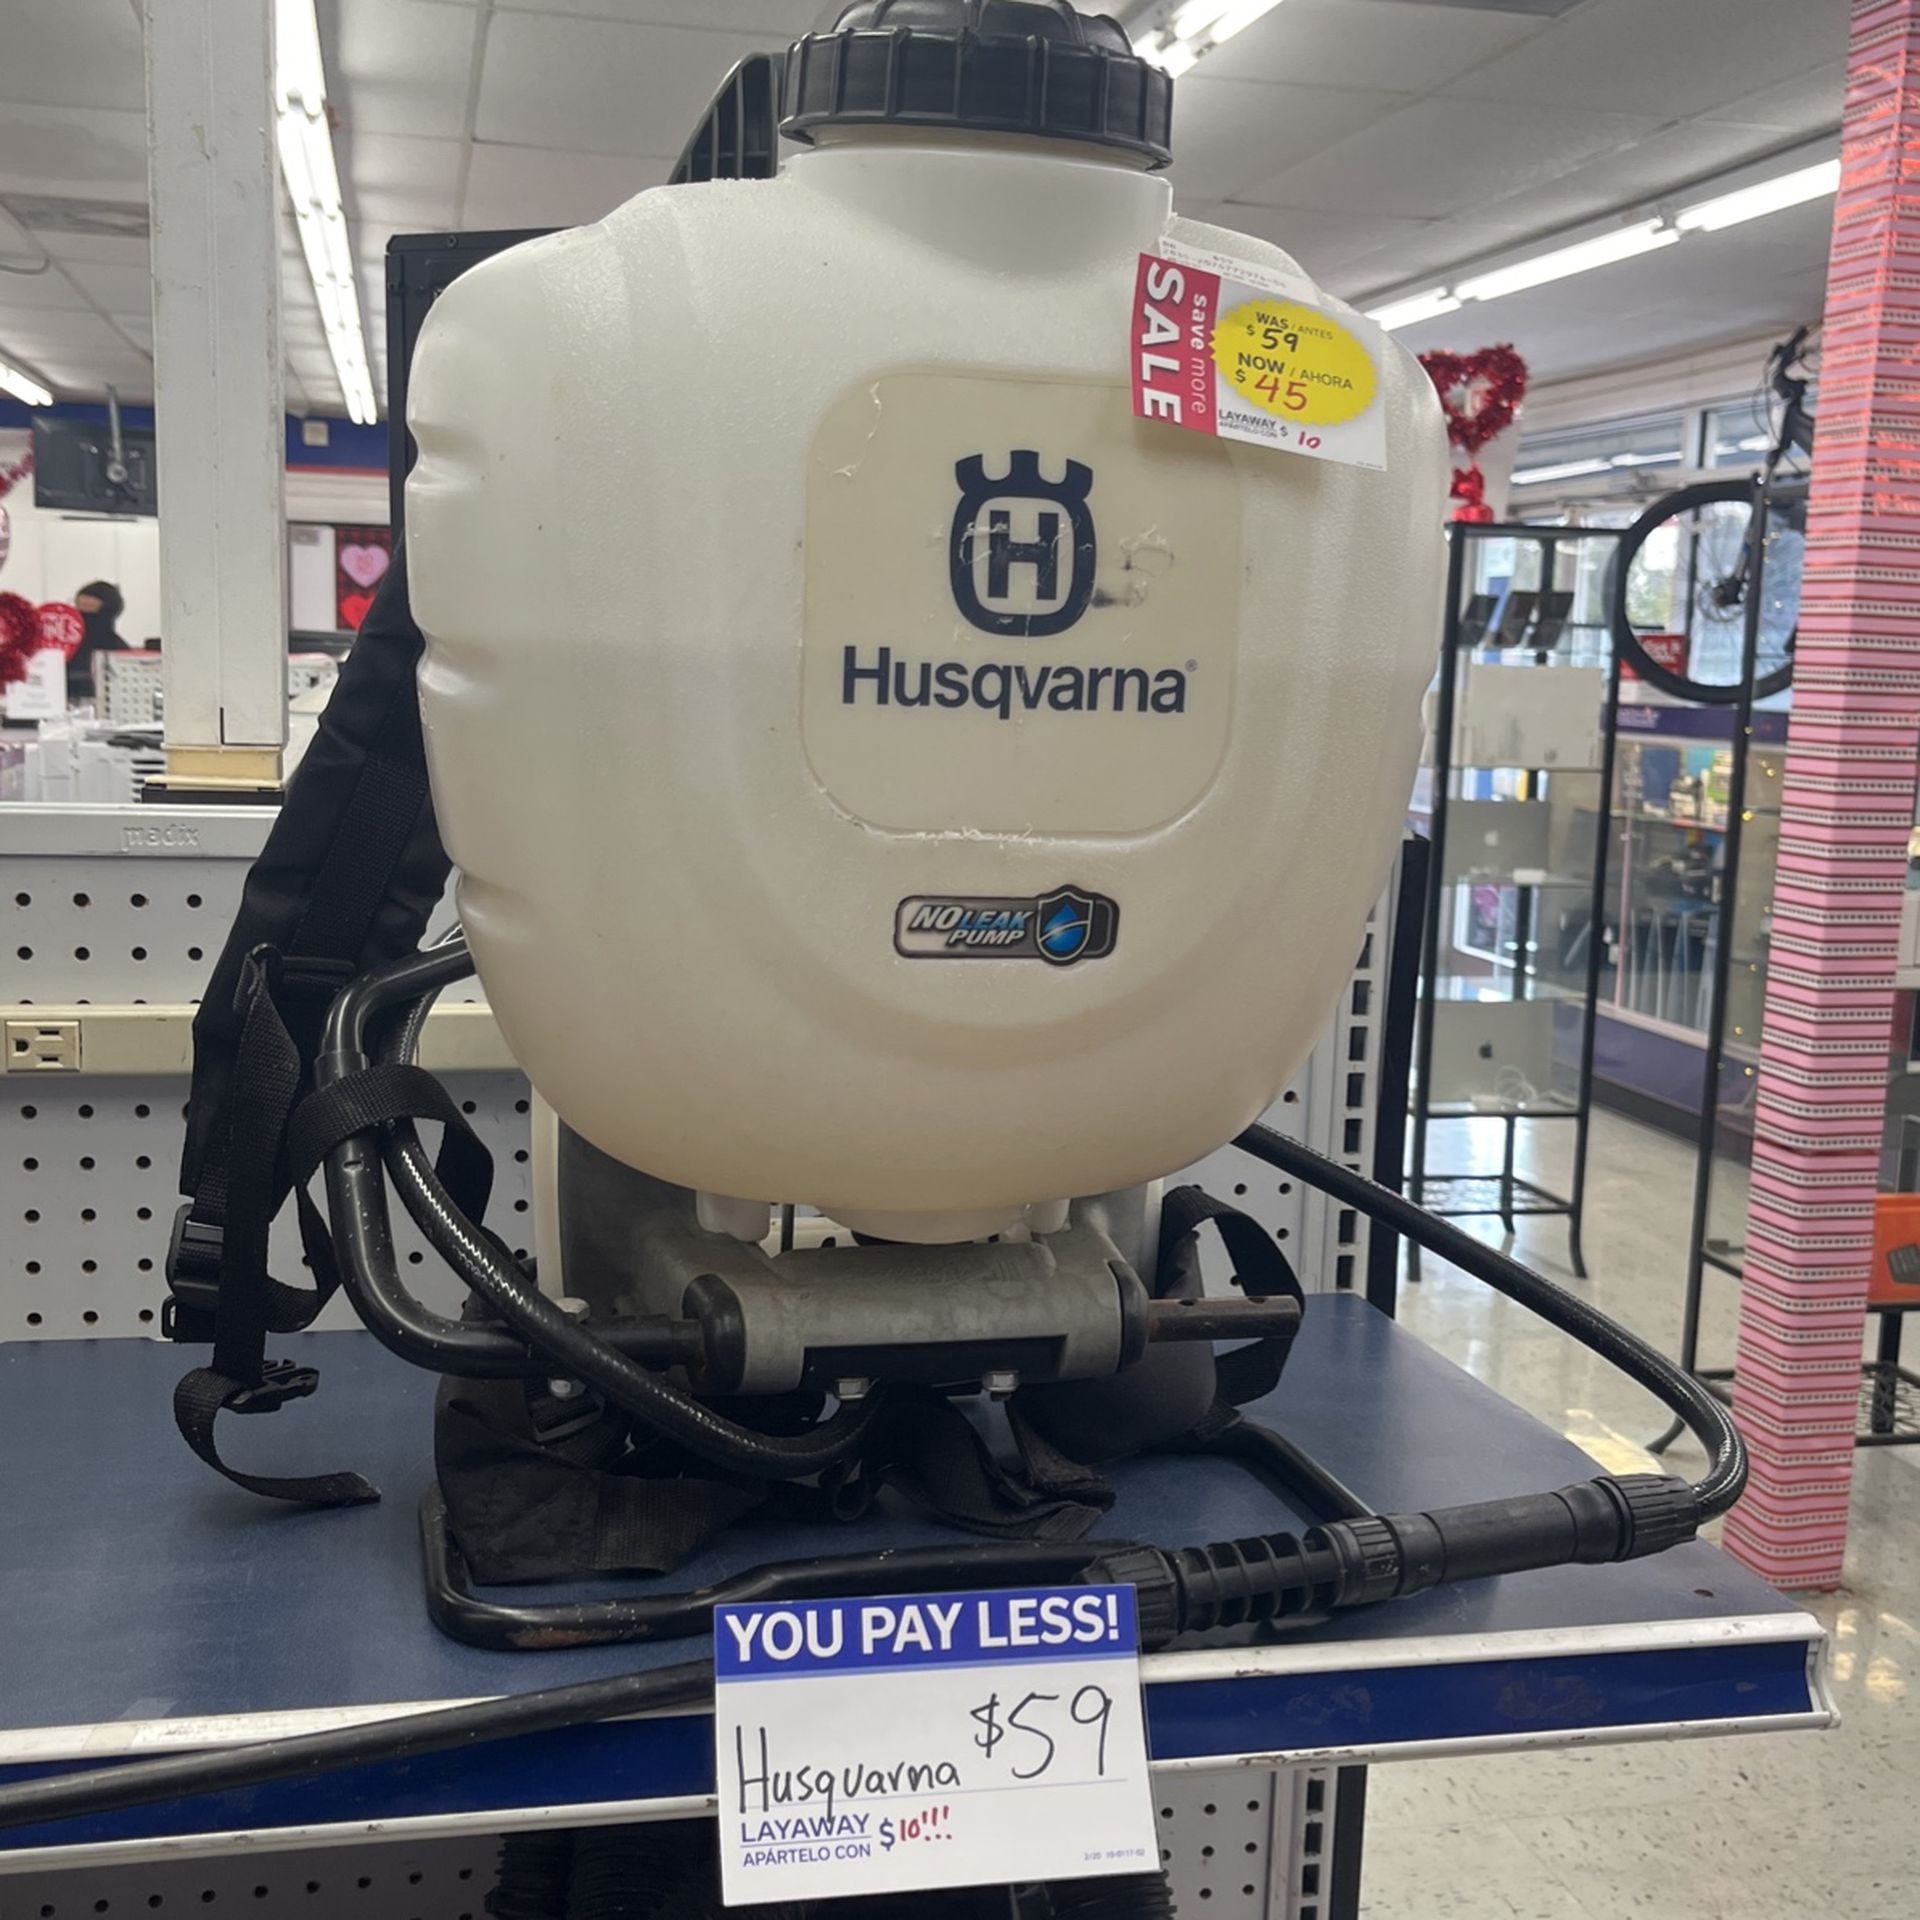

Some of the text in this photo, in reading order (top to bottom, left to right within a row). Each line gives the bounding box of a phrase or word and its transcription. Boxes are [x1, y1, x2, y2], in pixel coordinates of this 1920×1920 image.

[1255, 311, 1289, 330] WAS
[1141, 261, 1185, 423] SALE
[1190, 293, 1207, 414] save more
[1260, 329, 1299, 353] 59
[1235, 369, 1308, 412] $ 45
[1237, 352, 1285, 374] NOW
[1299, 369, 1353, 391] AHORA
[1218, 409, 1277, 430] LAYAWAY
[1298, 431, 1321, 449] 10
[987, 510, 1059, 600] H
[842, 645, 1186, 720] Husqvarna
[911, 905, 1034, 932] NO LEAK
[949, 929, 1025, 945] PUMP
[725, 1594, 1120, 1663] YOU PAY LESS!
[969, 1685, 1113, 1780] $59
[740, 1812, 871, 1844] LAYAWAY
[742, 1842, 872, 1869] APÁRTELO CON
